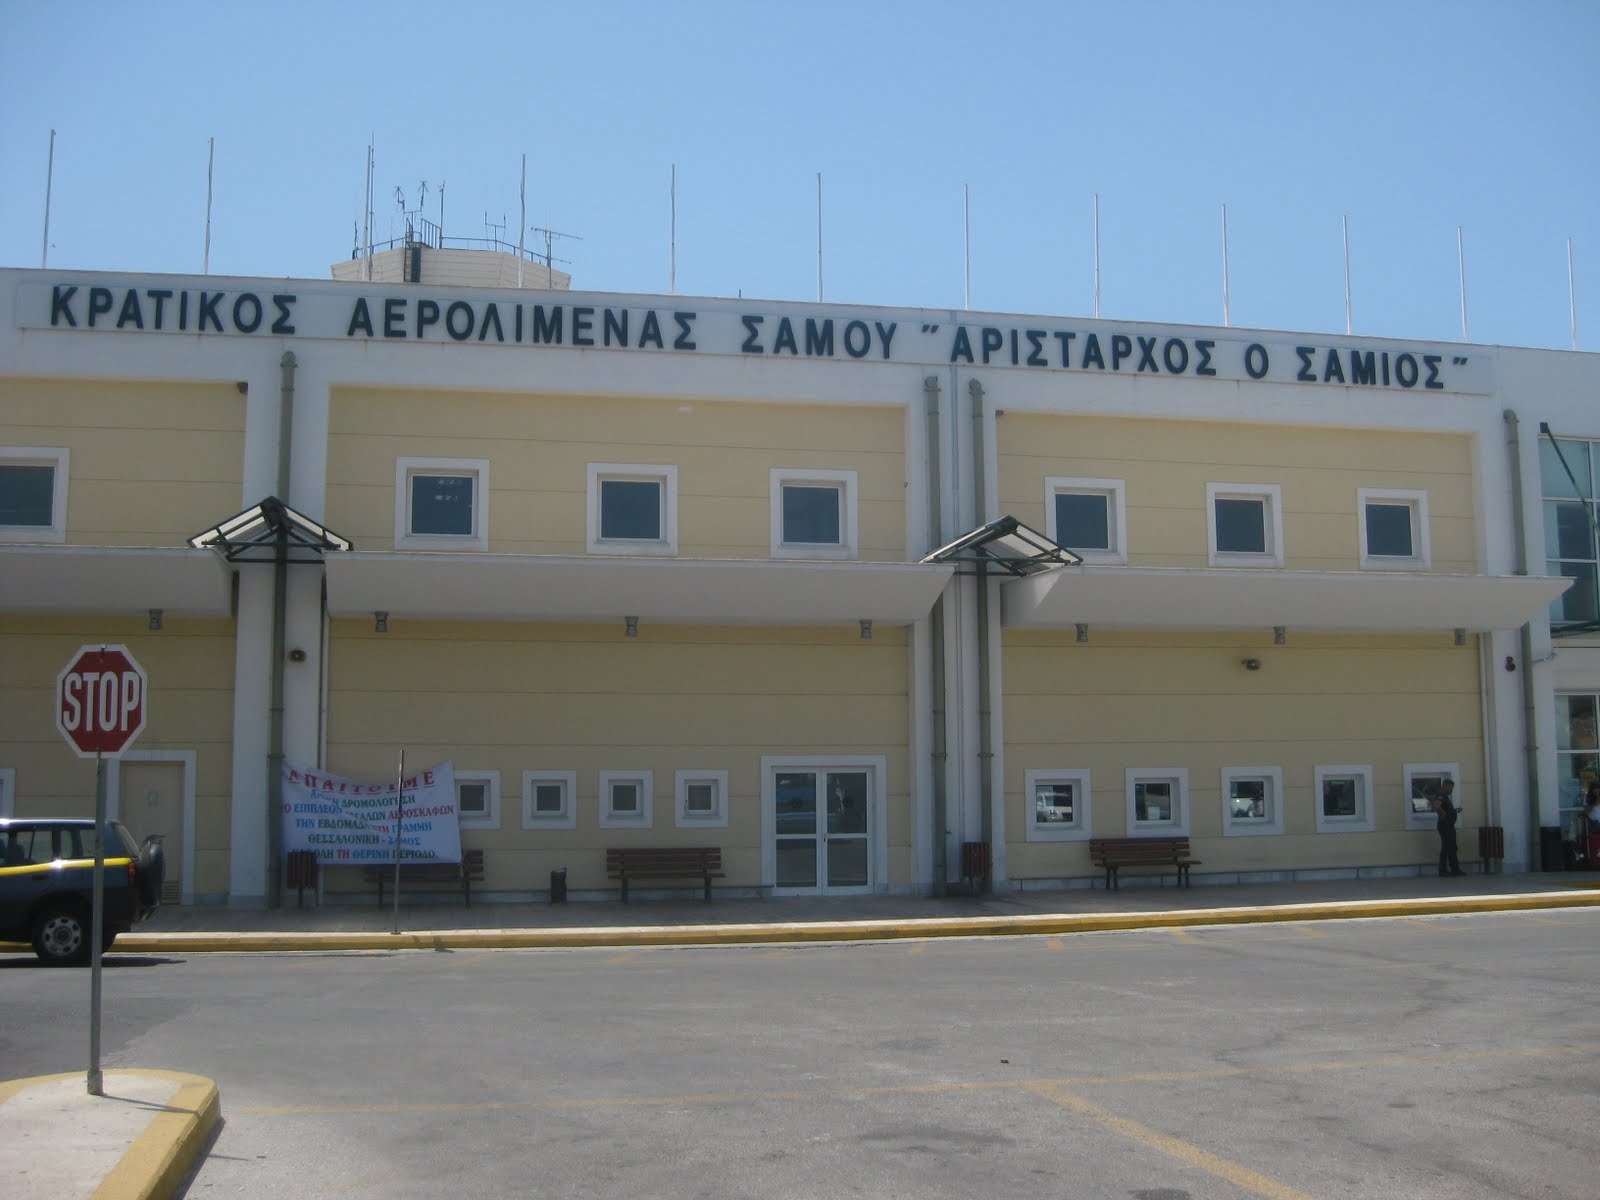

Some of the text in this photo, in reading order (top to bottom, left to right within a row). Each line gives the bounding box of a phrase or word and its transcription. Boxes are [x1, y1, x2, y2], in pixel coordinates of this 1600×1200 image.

[51, 286, 296, 334] ΚΡΑΤΙΚΟΣ
[347, 297, 697, 351] ΑΕΡΟΛΙΜΕΝΑΣ
[741, 315, 898, 360] ΣΑΜΟΥ
[1245, 343, 1270, 380] Ο
[63, 671, 140, 731] STOP
[295, 818, 316, 829] ΤΗΝ
[337, 848, 350, 859] ΤΗ
